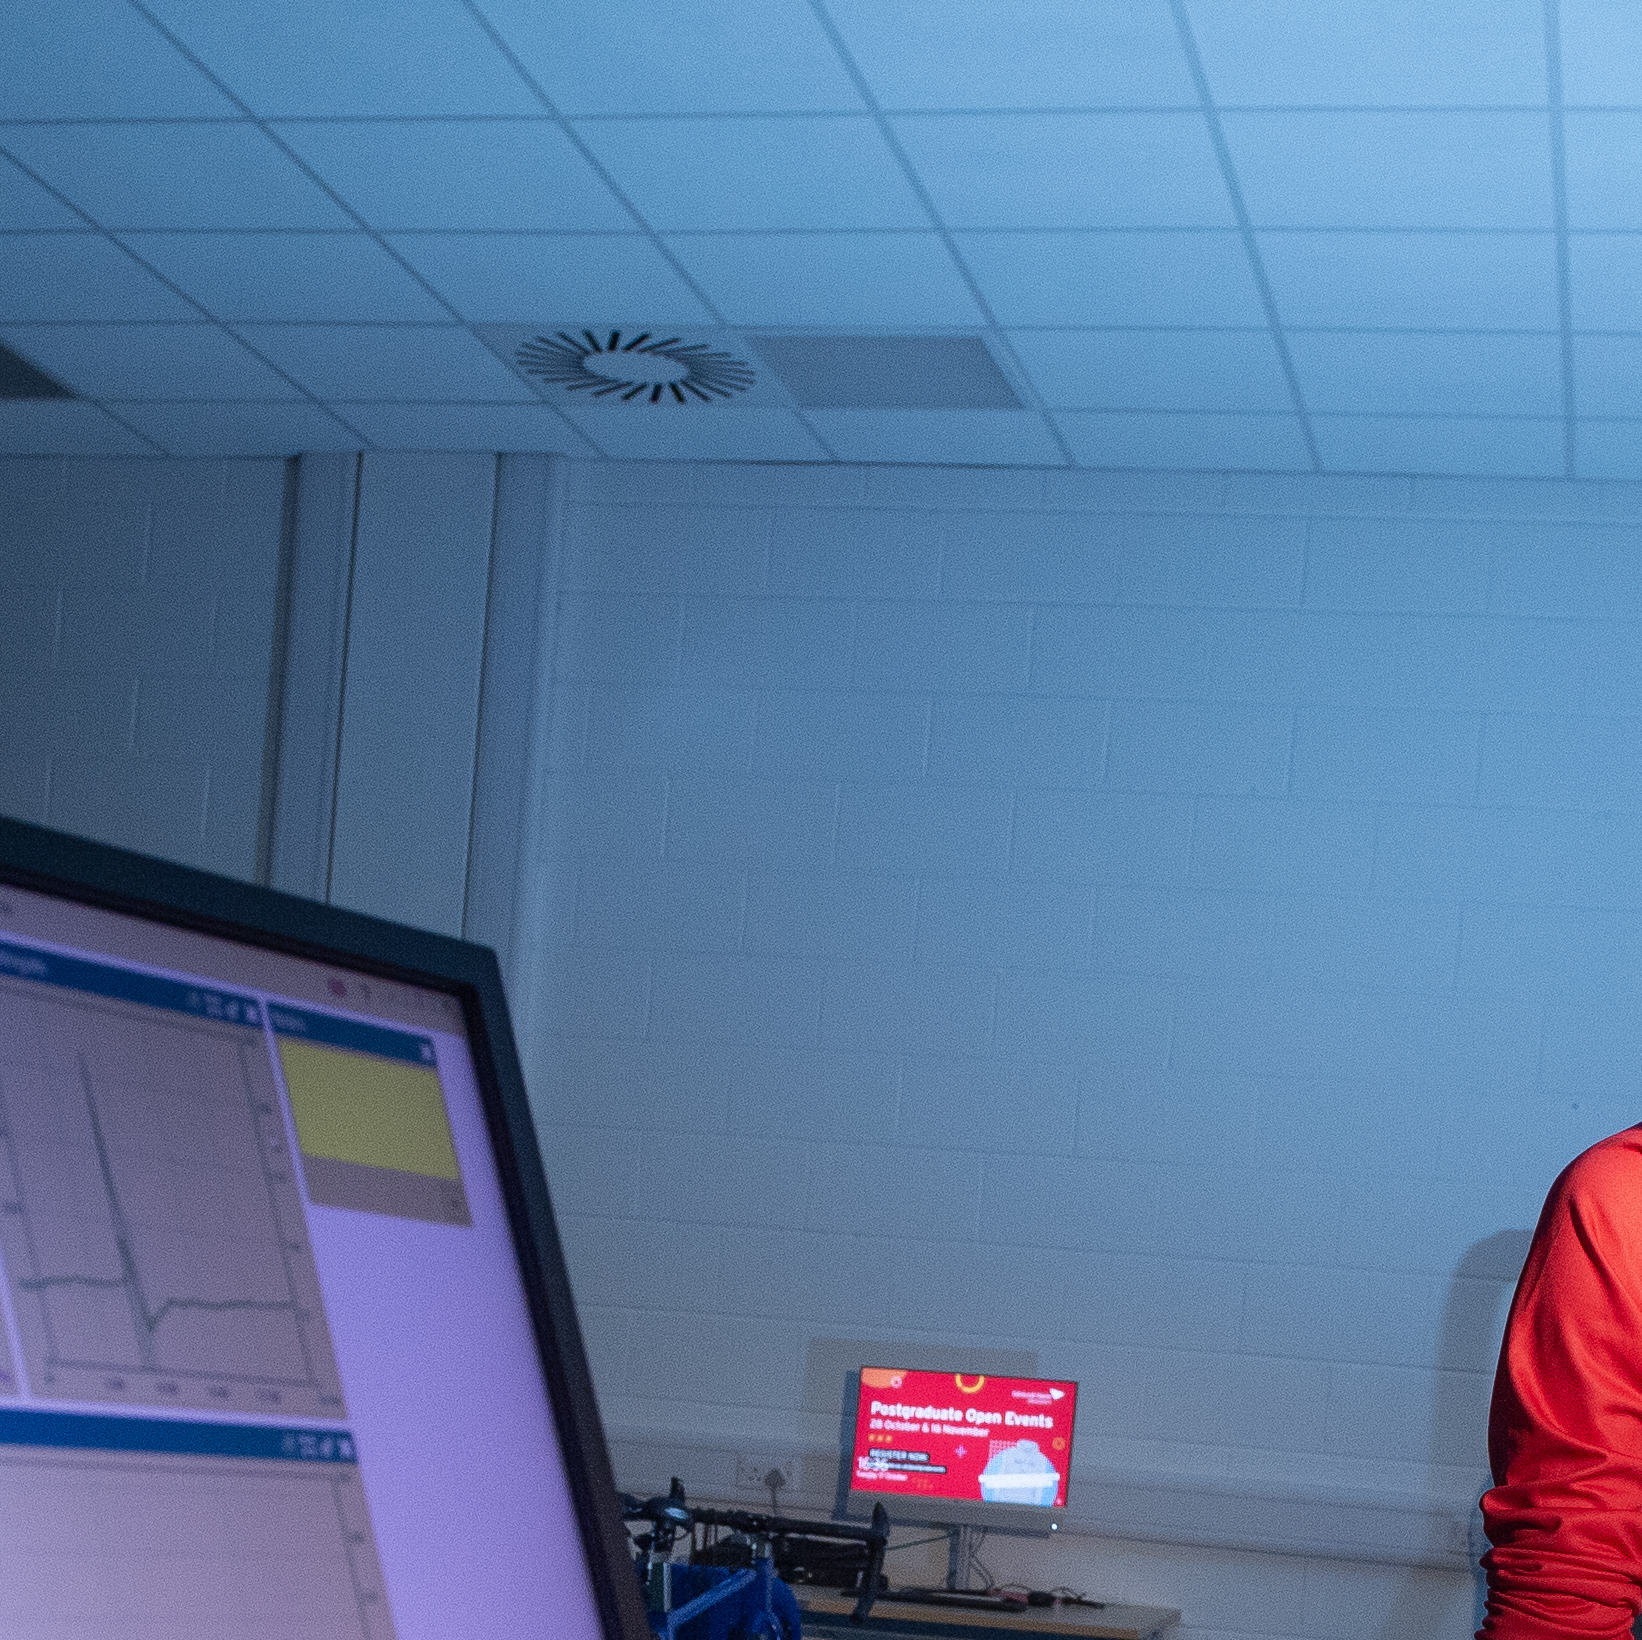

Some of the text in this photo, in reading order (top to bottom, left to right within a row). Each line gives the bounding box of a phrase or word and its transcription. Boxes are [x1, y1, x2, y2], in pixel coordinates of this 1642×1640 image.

[871, 1401, 1054, 1429] Postgraduate Open Events
[884, 1419, 920, 1432] October
[942, 1424, 990, 1438] November
